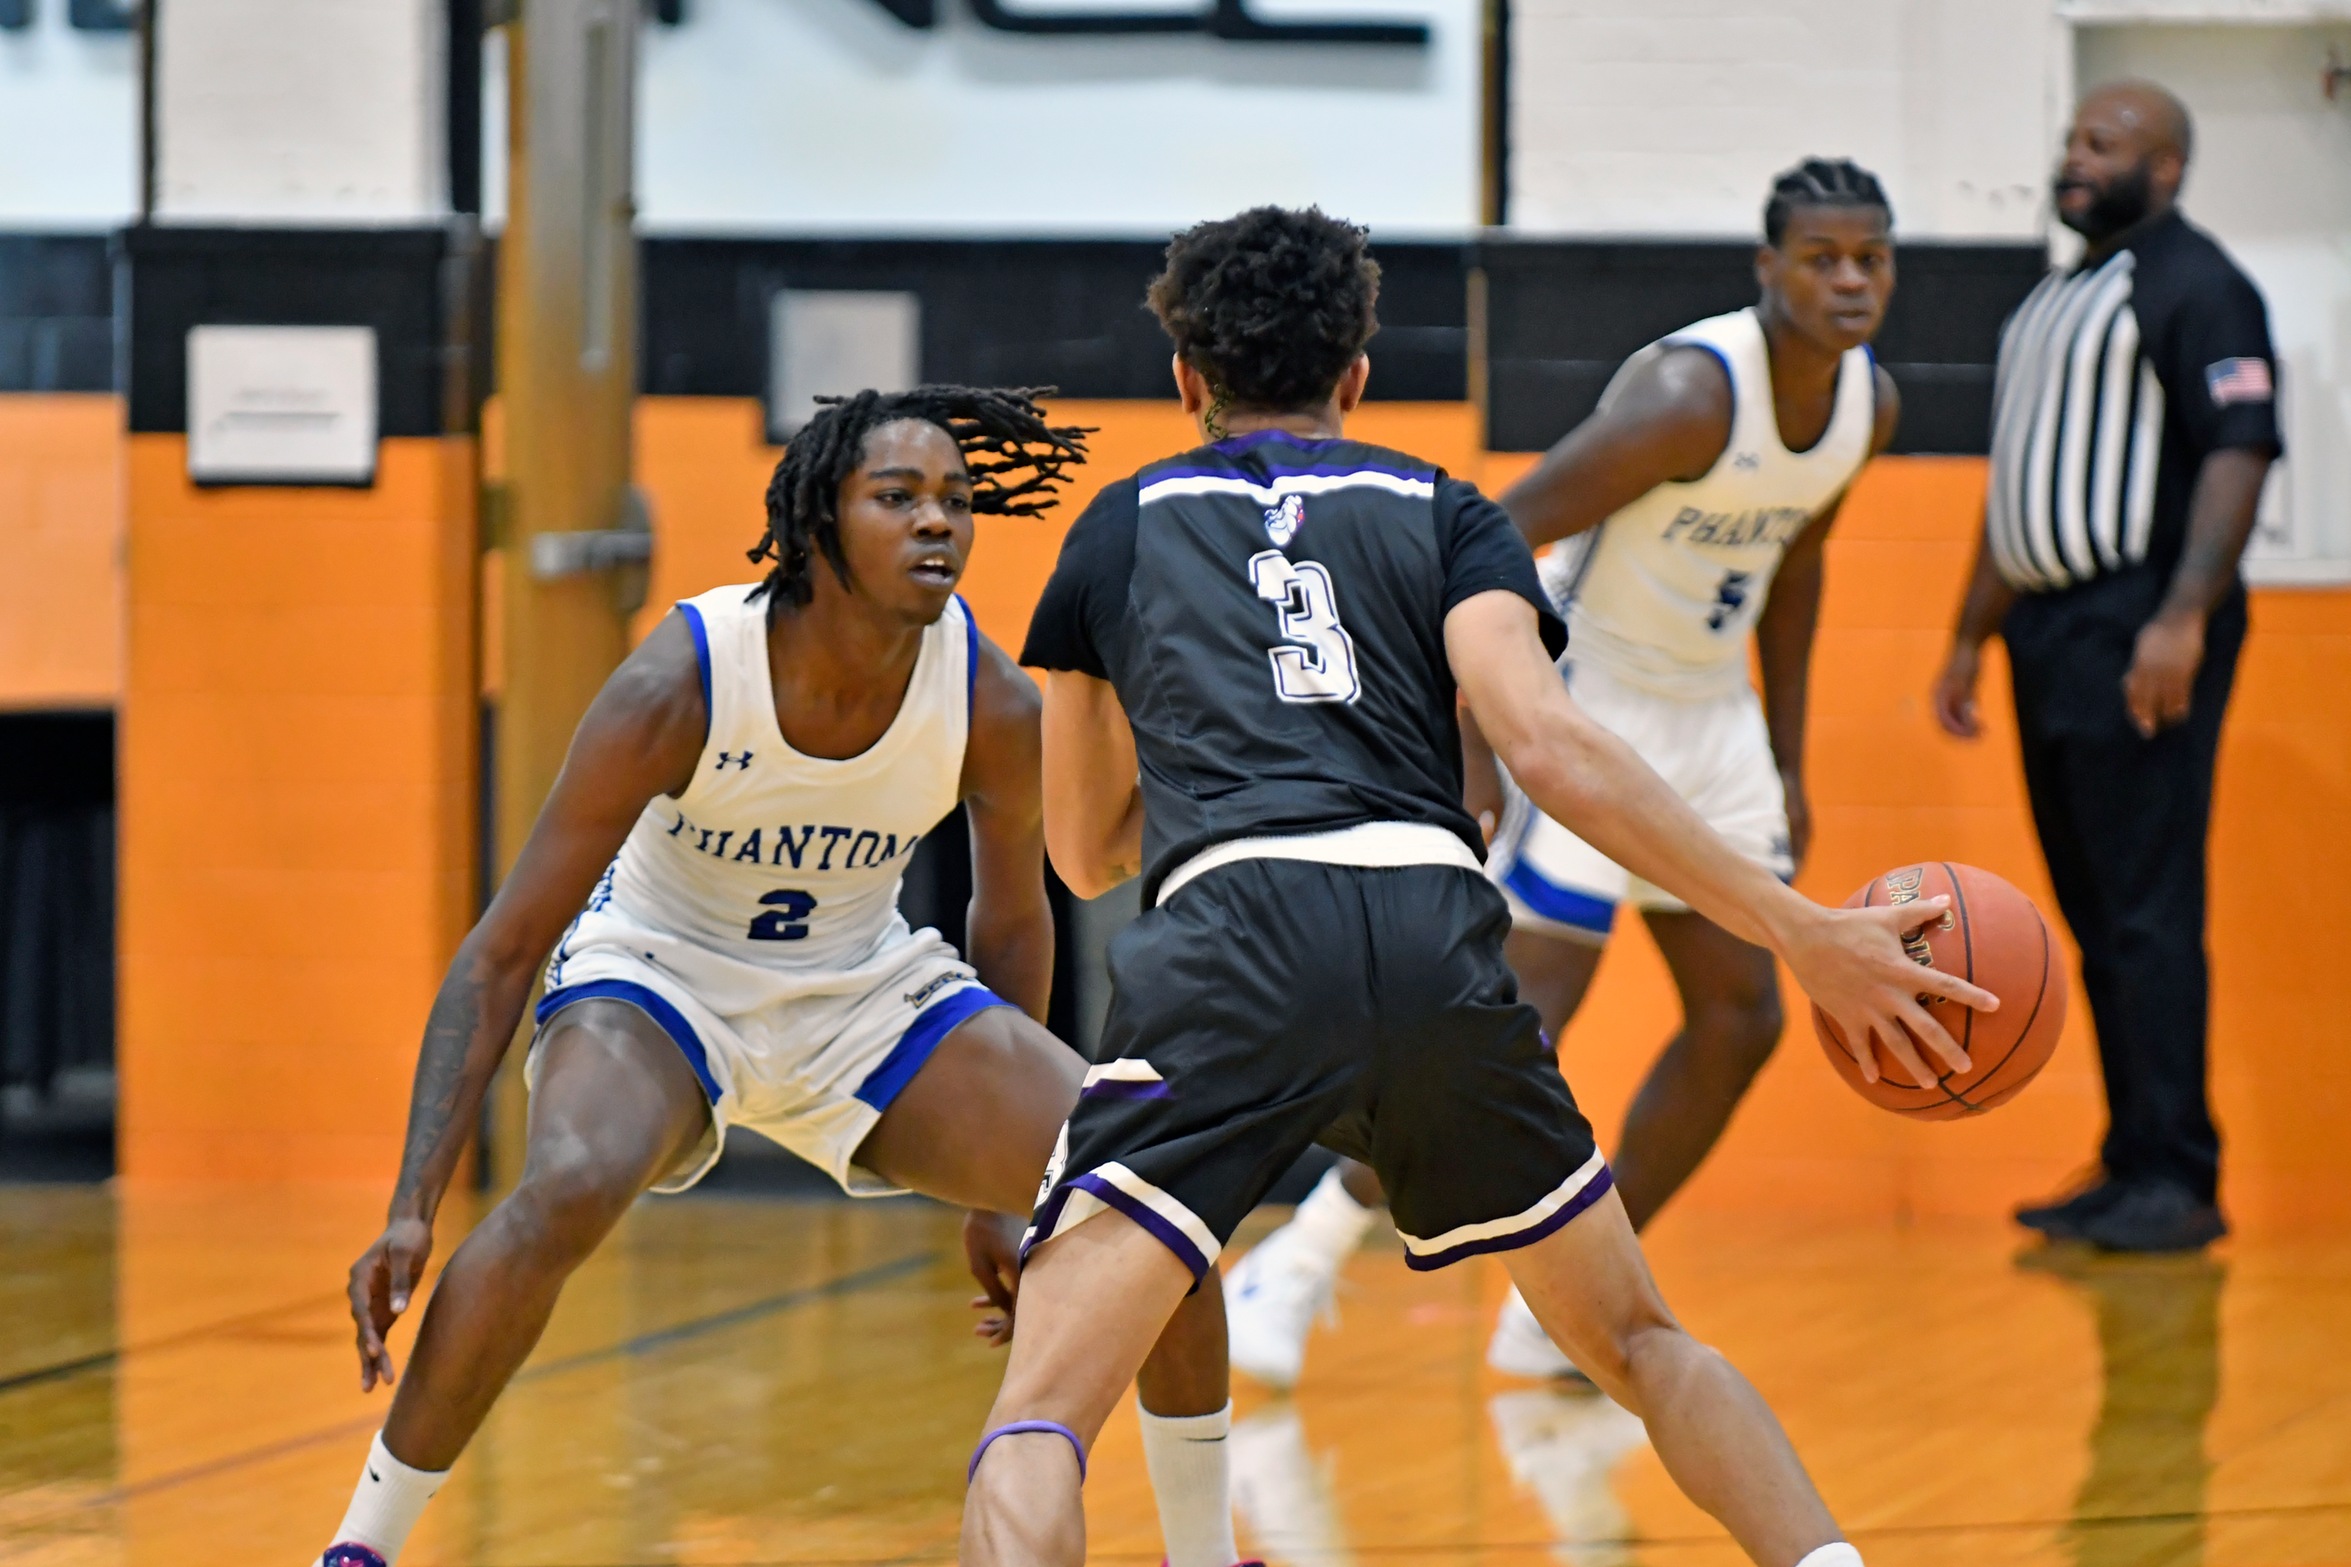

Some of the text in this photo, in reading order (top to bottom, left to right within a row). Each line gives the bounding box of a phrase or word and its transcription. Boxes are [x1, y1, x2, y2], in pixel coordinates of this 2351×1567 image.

[1248, 549, 1361, 704] 3
[1705, 568, 1753, 631] 5
[747, 889, 817, 939] 2
